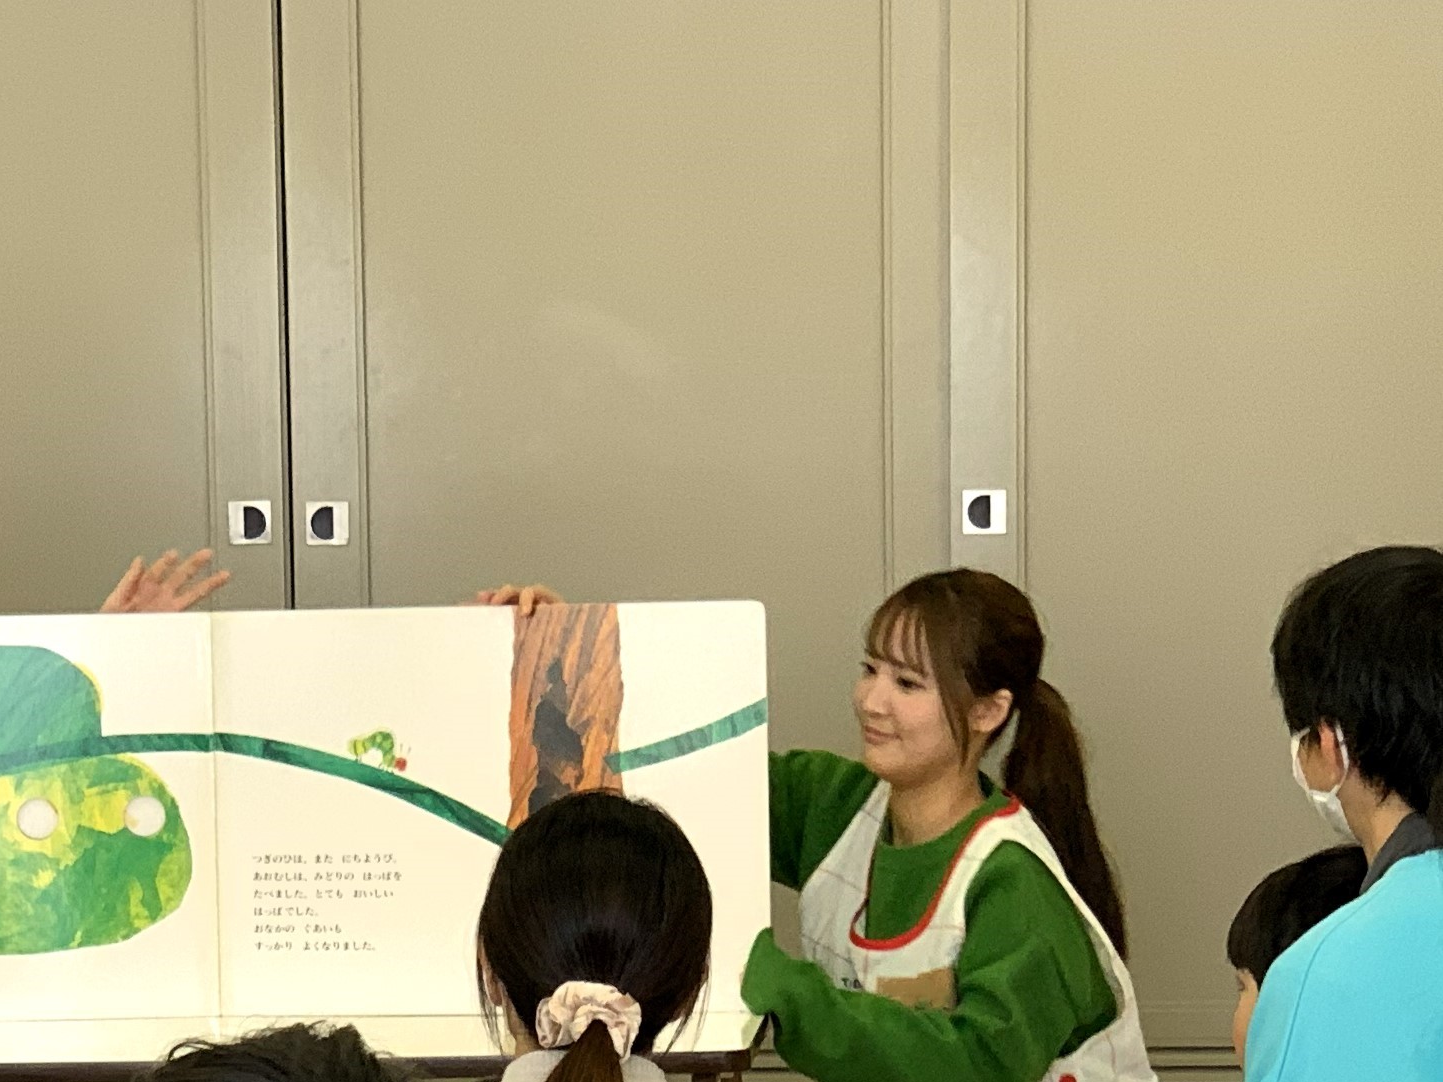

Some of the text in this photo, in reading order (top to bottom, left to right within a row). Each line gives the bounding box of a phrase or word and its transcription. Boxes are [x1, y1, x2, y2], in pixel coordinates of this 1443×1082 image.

[253, 924, 296, 934] おなかの
[254, 941, 293, 951] すっかり
